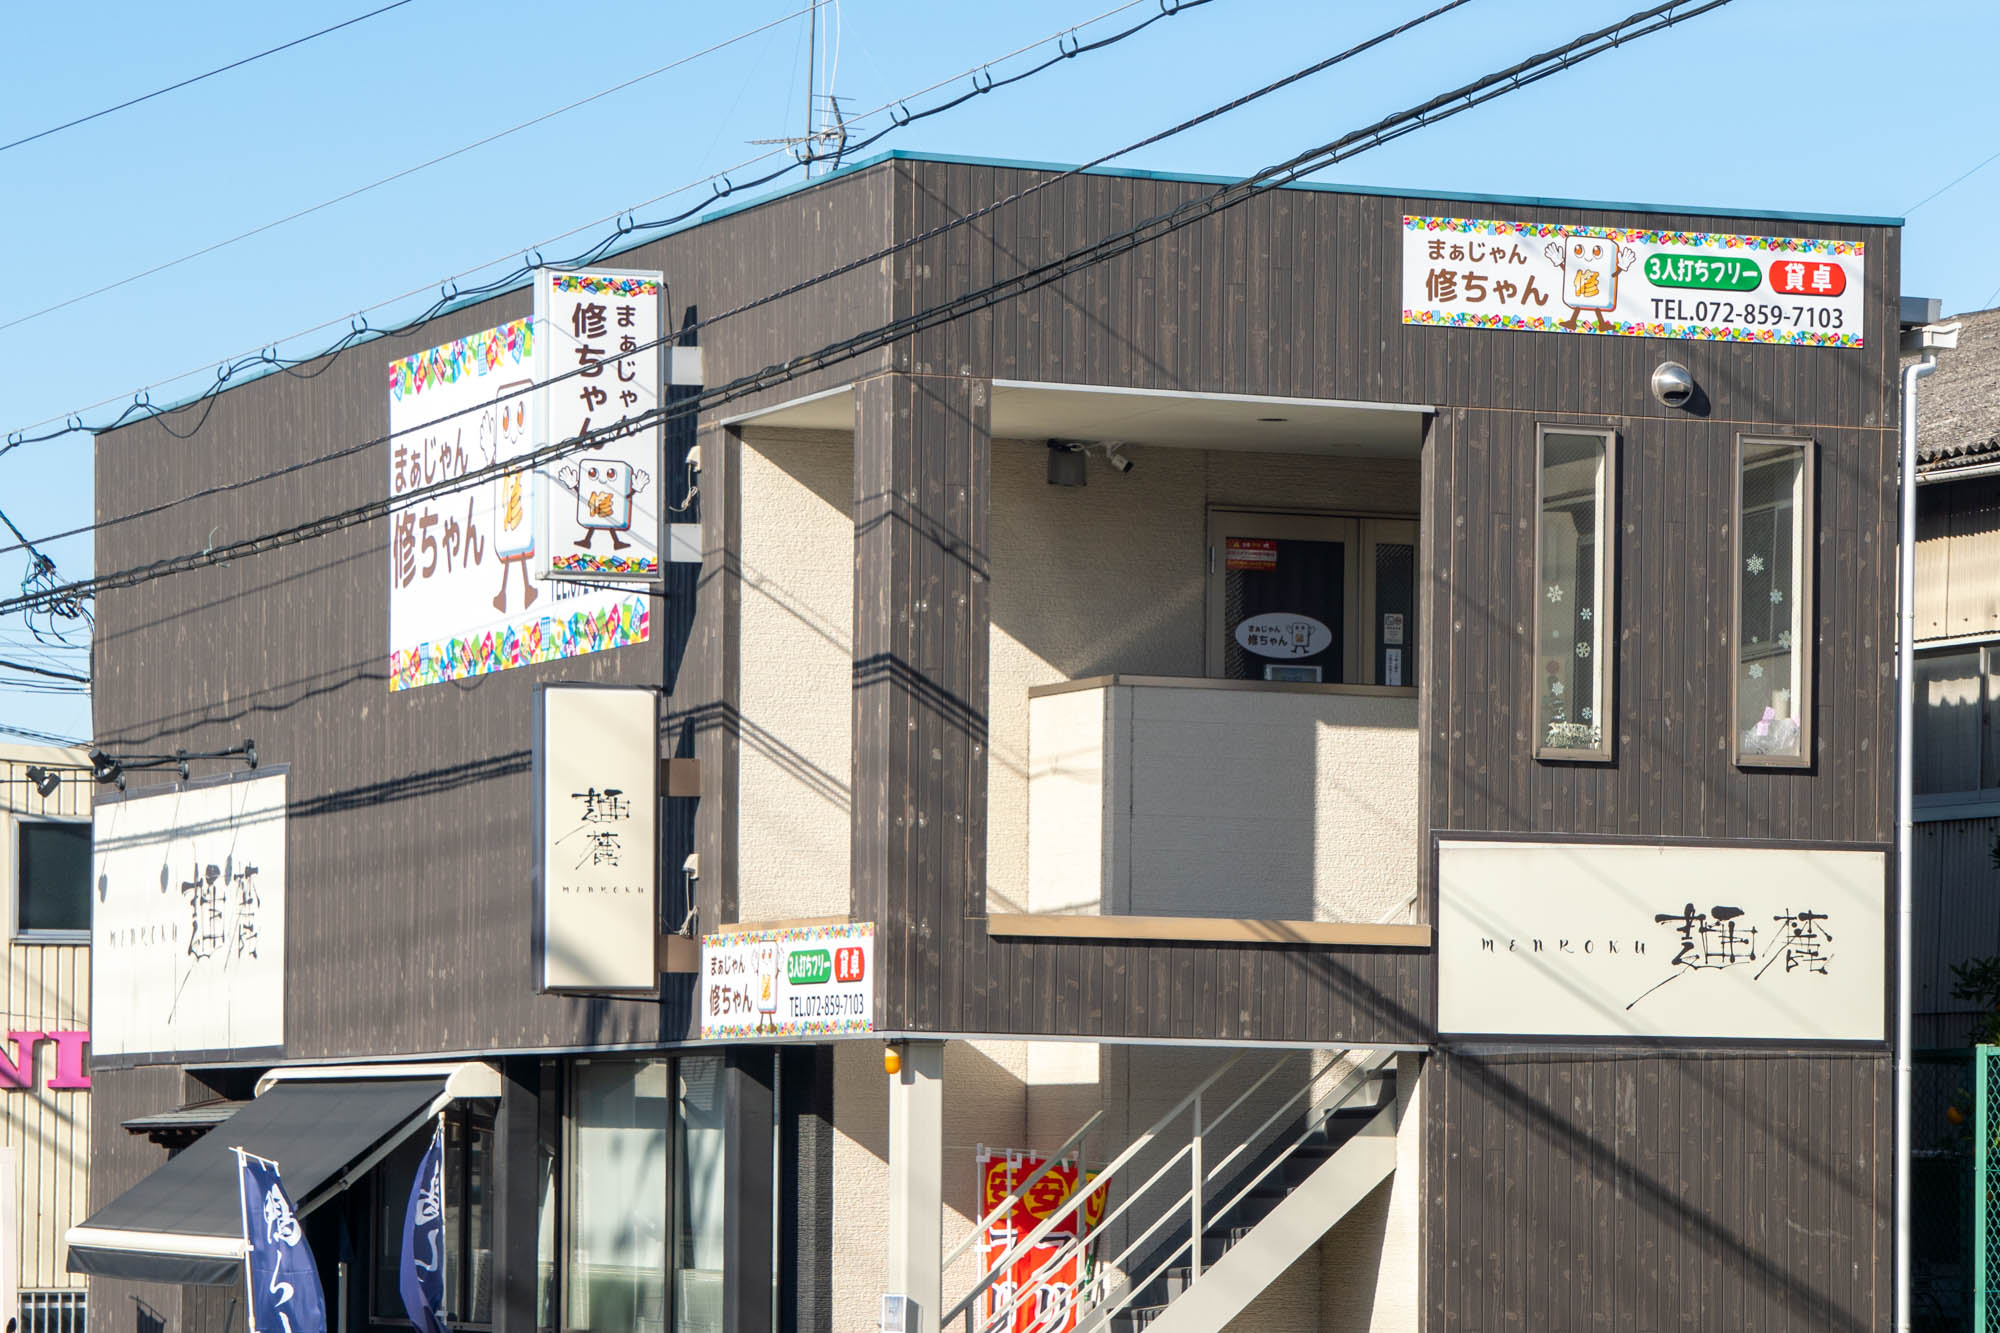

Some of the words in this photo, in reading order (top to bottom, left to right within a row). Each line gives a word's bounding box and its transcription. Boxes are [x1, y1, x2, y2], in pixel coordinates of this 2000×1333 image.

[1427, 239, 1528, 266] まぁじゃん
[1425, 268, 1549, 307] 修ちゃん
[1649, 257, 1759, 288] 3人打ちフリー
[1784, 263, 1832, 293] 貸卓
[1651, 298, 1844, 329] TEL.072-859-7103
[395, 428, 468, 493] まぁじゃん
[393, 495, 485, 590] 修ちゃん
[711, 954, 746, 977] まぁじゃん
[789, 953, 831, 979] 3人打ちフリー
[840, 949, 861, 979] 貸卓
[710, 983, 753, 1017] 修ちゃん
[789, 993, 865, 1018] TEL.072-859-7103
